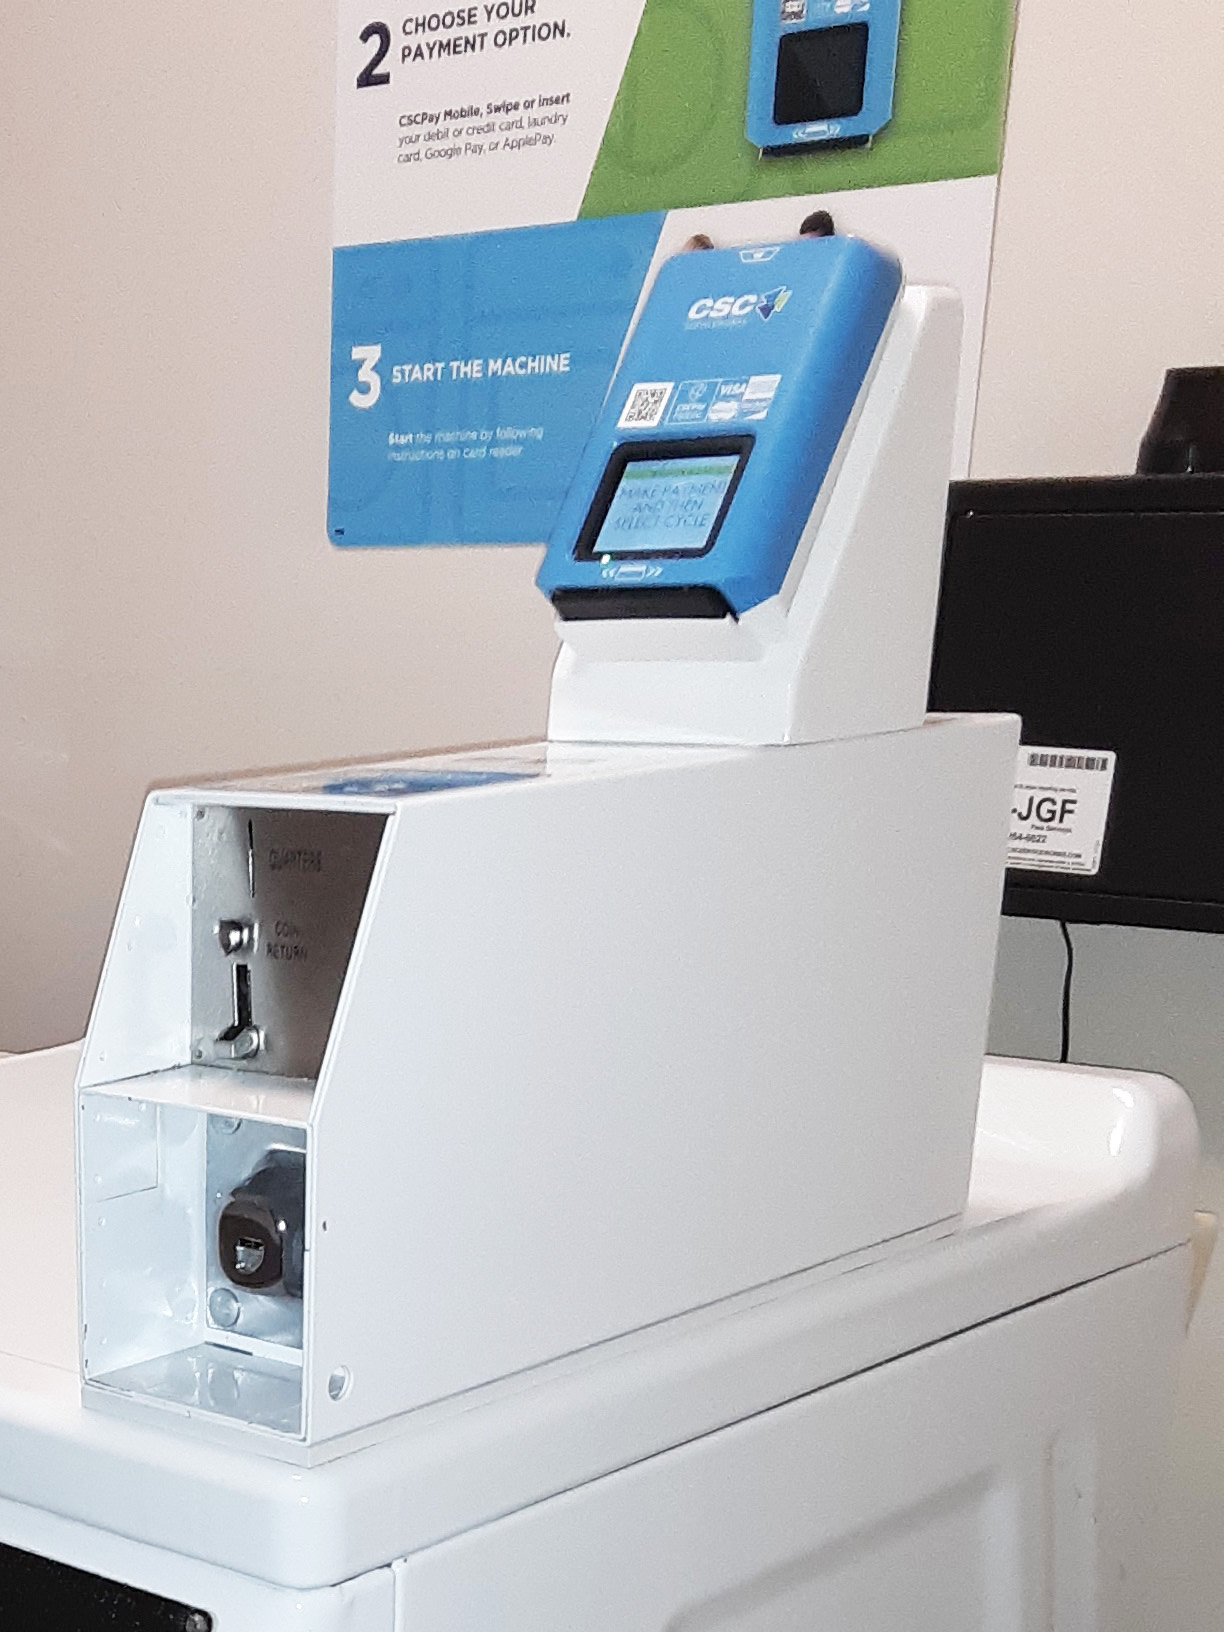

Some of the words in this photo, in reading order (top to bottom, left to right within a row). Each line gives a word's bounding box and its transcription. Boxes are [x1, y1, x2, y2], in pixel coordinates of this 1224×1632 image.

[402, 6, 478, 36] CHOOSE
[483, 0, 536, 22] YOUR
[356, 21, 391, 89] 2
[401, 32, 488, 64] PAYMENT
[493, 19, 571, 49] OPTION.
[399, 111, 441, 128] CSCPay
[443, 104, 483, 122] Mobile,
[486, 99, 519, 116] Swipe
[523, 98, 535, 109] or
[538, 92, 570, 108] insert
[398, 133, 421, 148] your
[424, 127, 449, 142] debit
[452, 127, 464, 138] or
[466, 121, 495, 136] credit
[528, 112, 569, 130] laundry
[425, 144, 462, 161] Google
[489, 141, 499, 151] or
[687, 294, 759, 320] CSC
[348, 344, 382, 409] 3
[392, 361, 446, 384] START
[450, 359, 484, 381] THE
[488, 353, 571, 377] MACHINE
[388, 432, 414, 447] Start
[266, 942, 308, 961] RETURN
